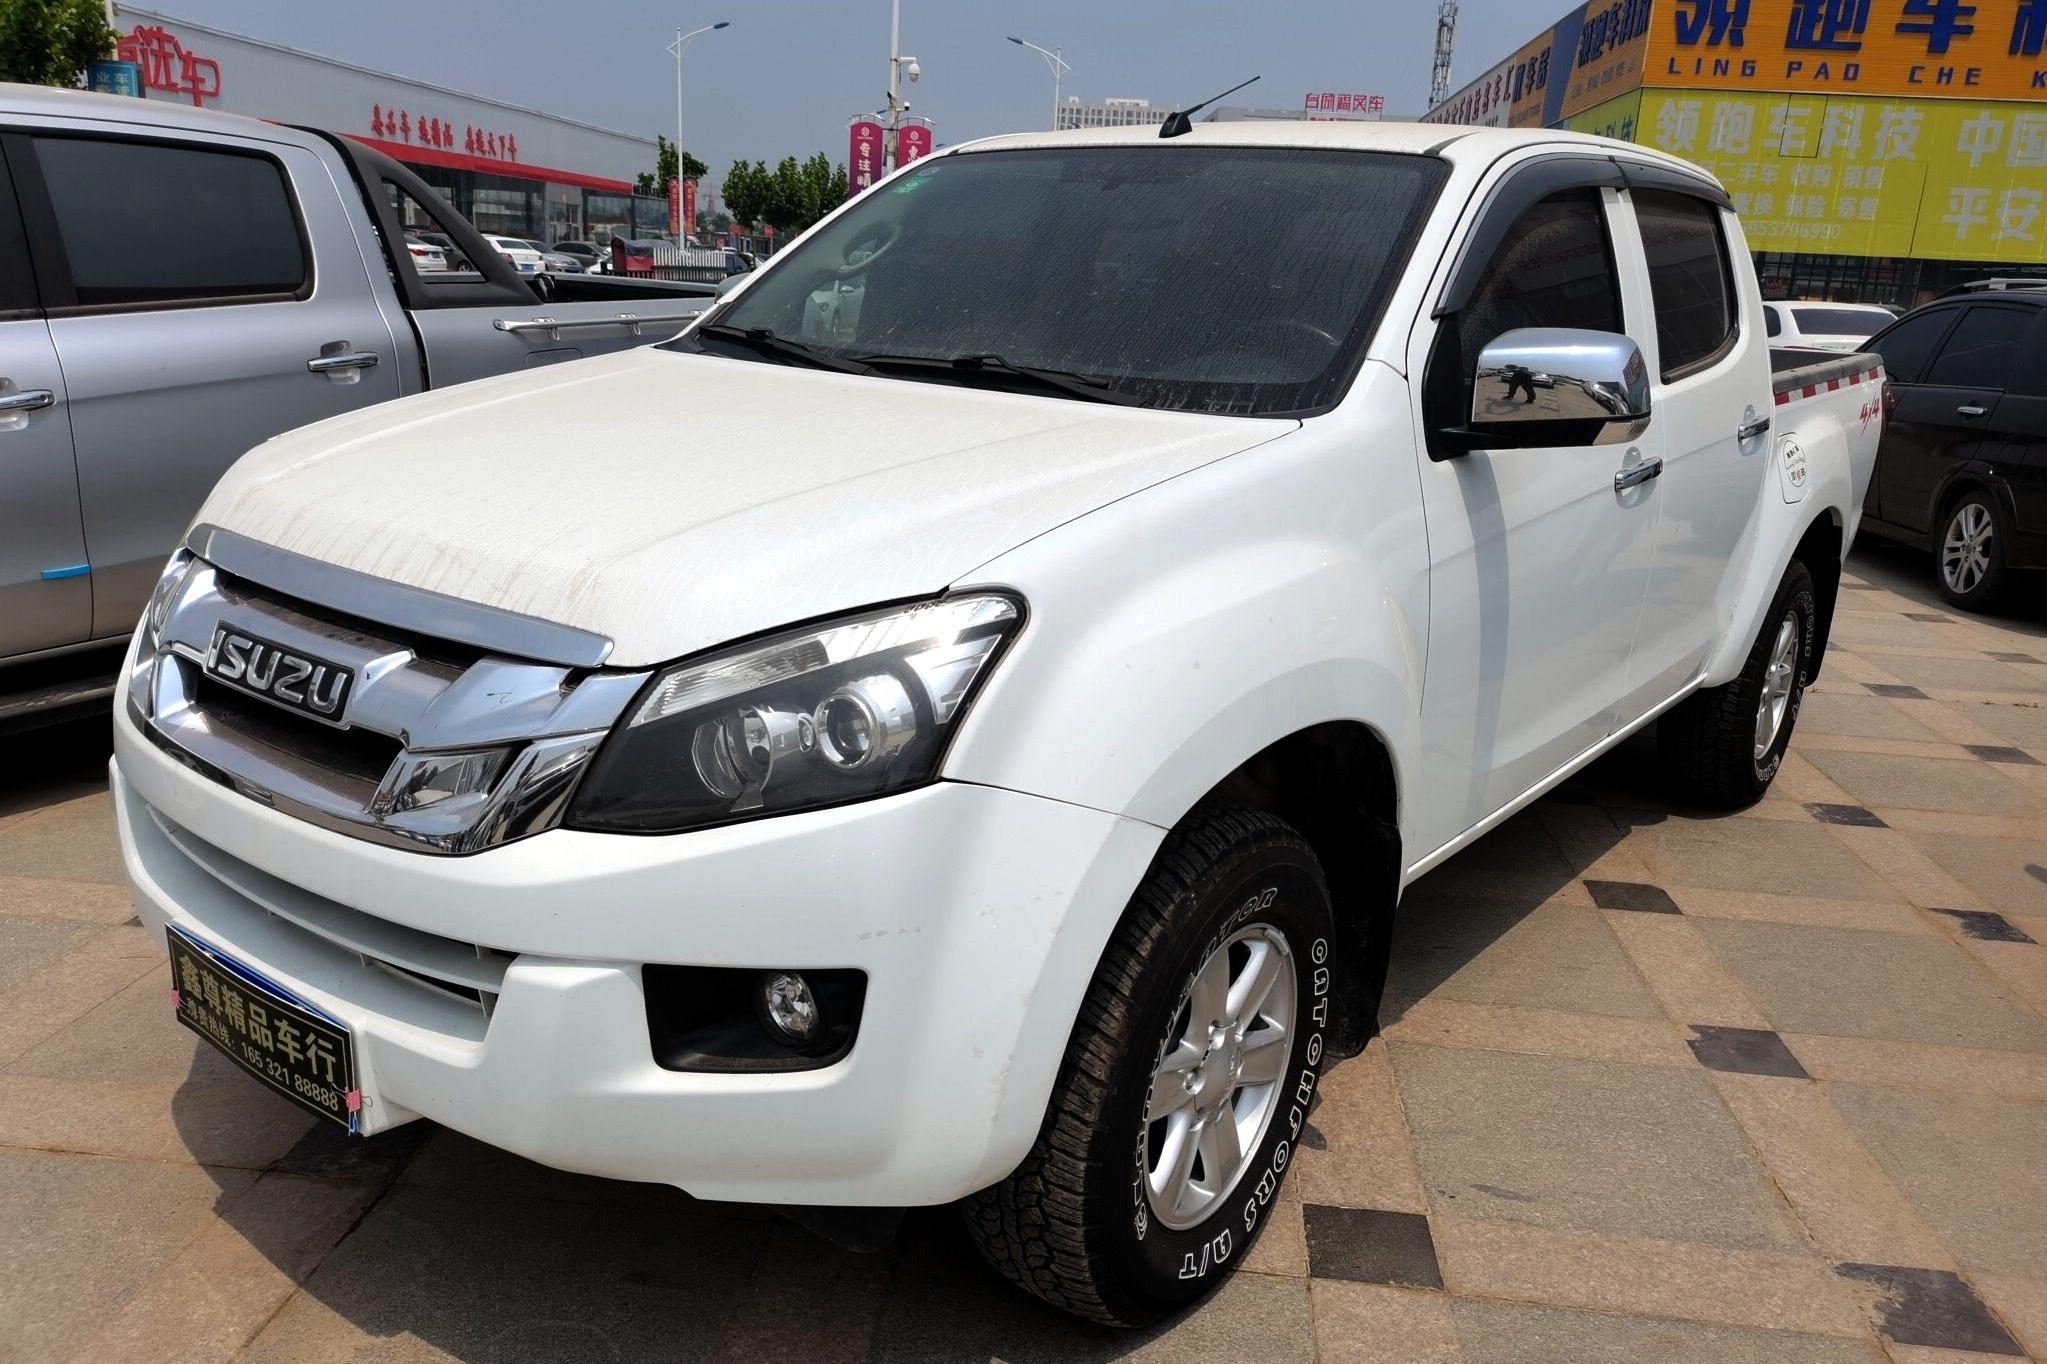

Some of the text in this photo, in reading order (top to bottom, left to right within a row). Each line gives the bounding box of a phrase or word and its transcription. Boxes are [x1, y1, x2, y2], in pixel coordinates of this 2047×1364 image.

[1668, 57, 1758, 78] LING
[1785, 60, 1861, 81] PAO
[1908, 65, 1983, 86] CHE
[1656, 98, 1925, 161] 领跑车科技
[1941, 187, 2044, 241] 平安
[207, 629, 349, 714] ISUZU
[178, 953, 337, 1083] 鑫尊精品车行
[241, 1041, 264, 1069] 165
[265, 1056, 291, 1086] 321
[294, 1074, 340, 1112] 88888
